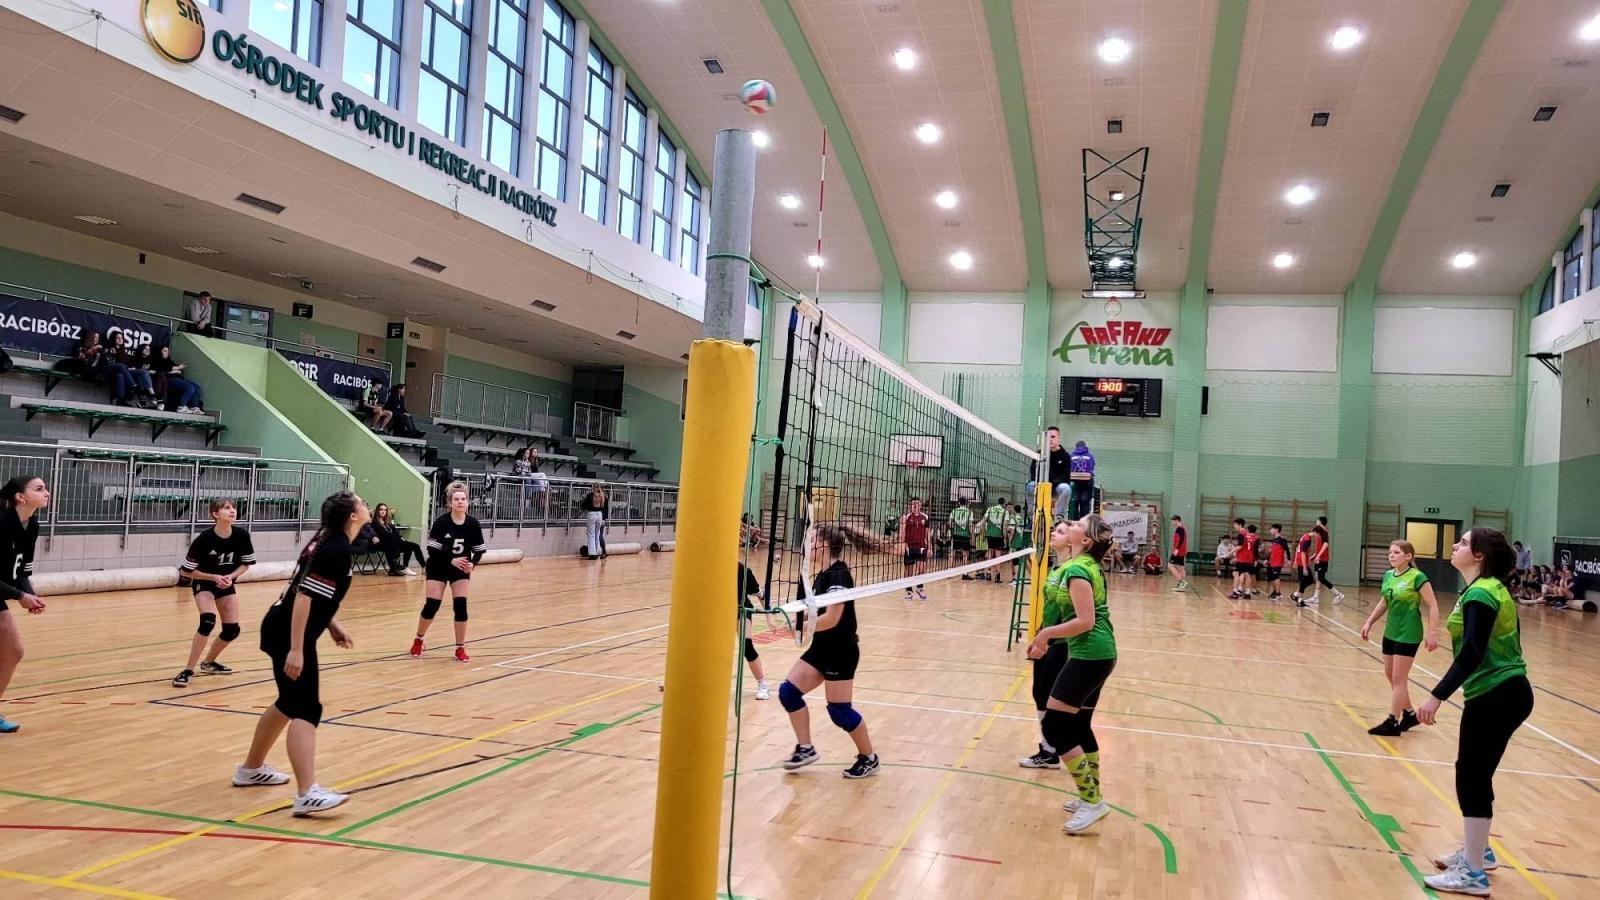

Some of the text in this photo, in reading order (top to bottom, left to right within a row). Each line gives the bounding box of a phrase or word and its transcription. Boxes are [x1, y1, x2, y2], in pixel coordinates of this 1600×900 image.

[212, 29, 558, 227] OŚRODEK SPORTU I REKREACJI RACIBÓRZ
[1080, 321, 1172, 346] RAFAKO
[1052, 321, 1174, 366] Arena
[333, 373, 373, 389] RACIBÓR
[451, 538, 465, 555] 5
[217, 551, 235, 566] 11
[1574, 557, 1600, 574] RACIBÓR
